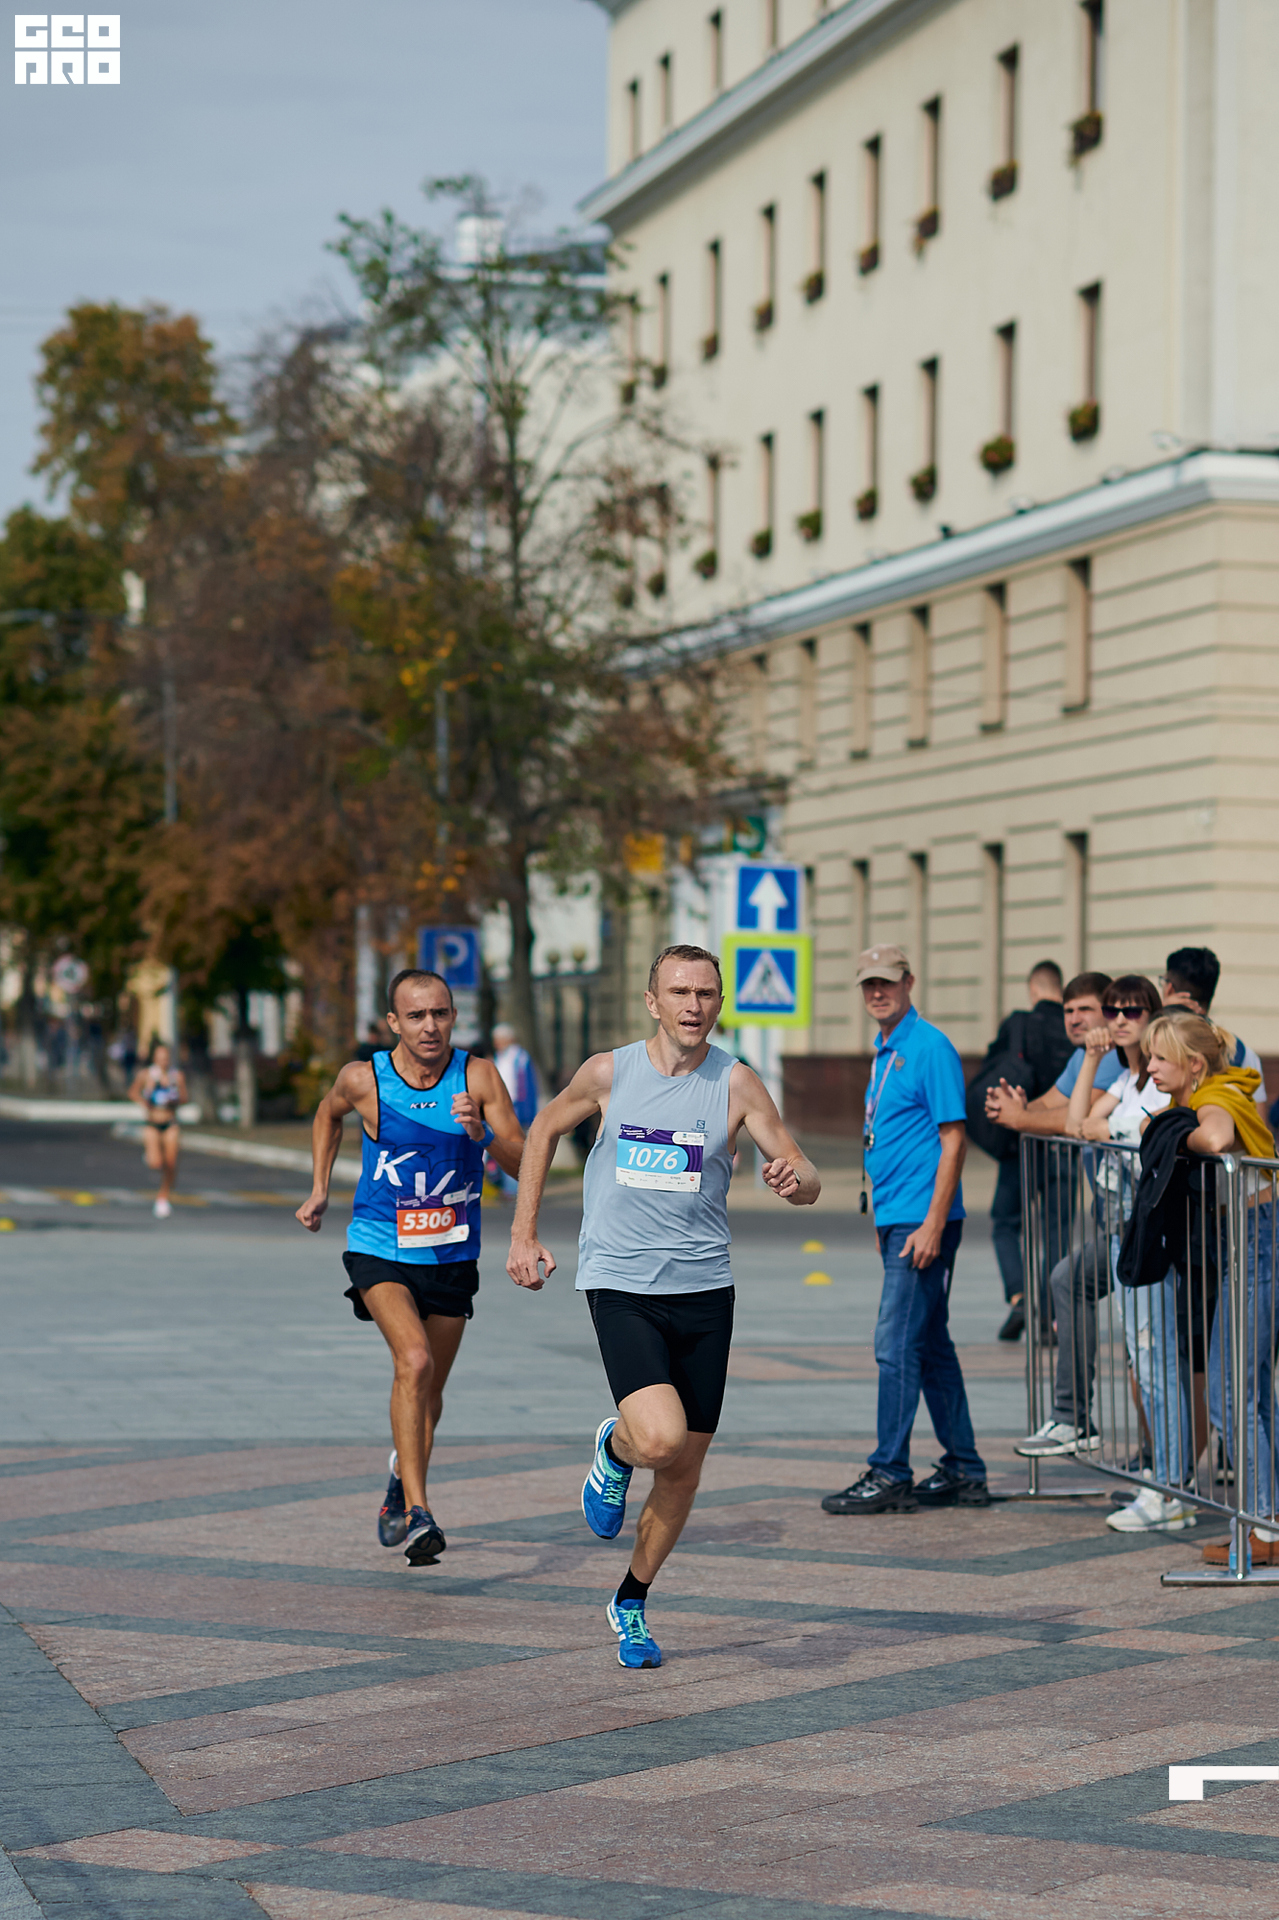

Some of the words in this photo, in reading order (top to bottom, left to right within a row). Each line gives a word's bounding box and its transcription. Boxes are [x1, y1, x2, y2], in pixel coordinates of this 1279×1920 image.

[434, 935, 469, 978] P
[628, 1146, 678, 1170] 1076
[402, 1209, 452, 1231] 5306
